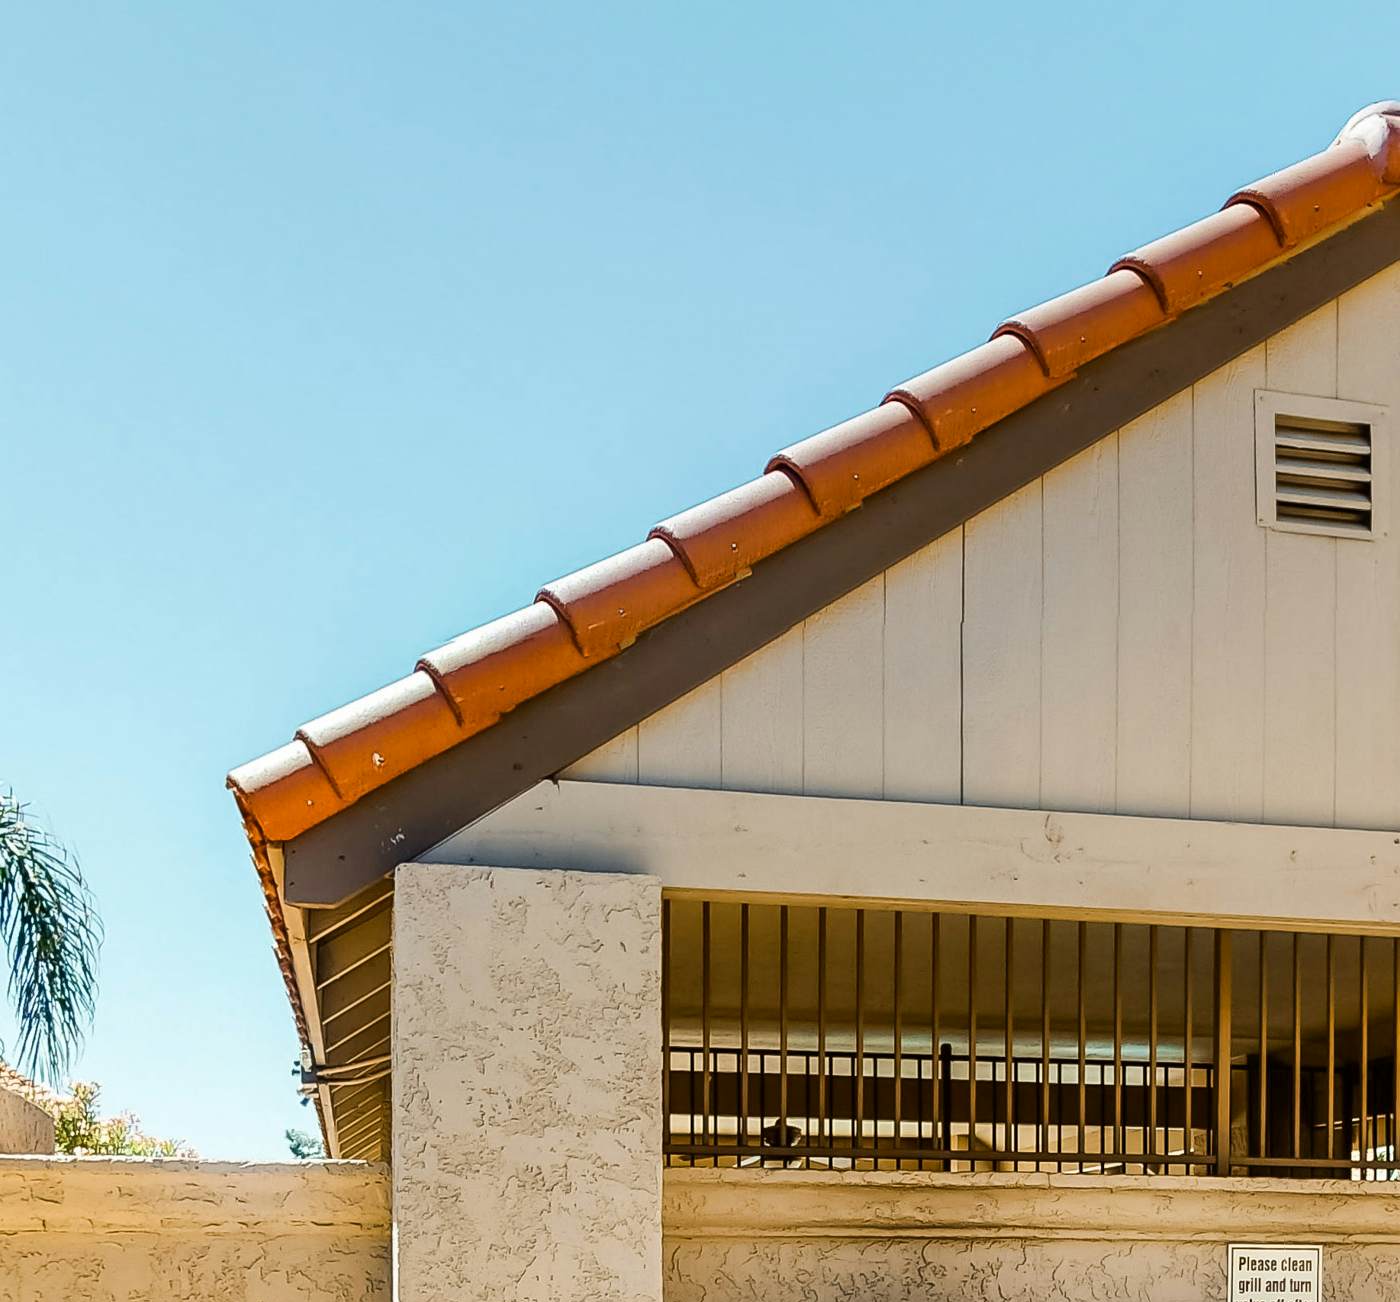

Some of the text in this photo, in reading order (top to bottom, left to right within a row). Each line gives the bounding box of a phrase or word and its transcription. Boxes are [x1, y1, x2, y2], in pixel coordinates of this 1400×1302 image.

[1238, 1257, 1312, 1271] Please clean
[1239, 1278, 1311, 1294] grill and turn
